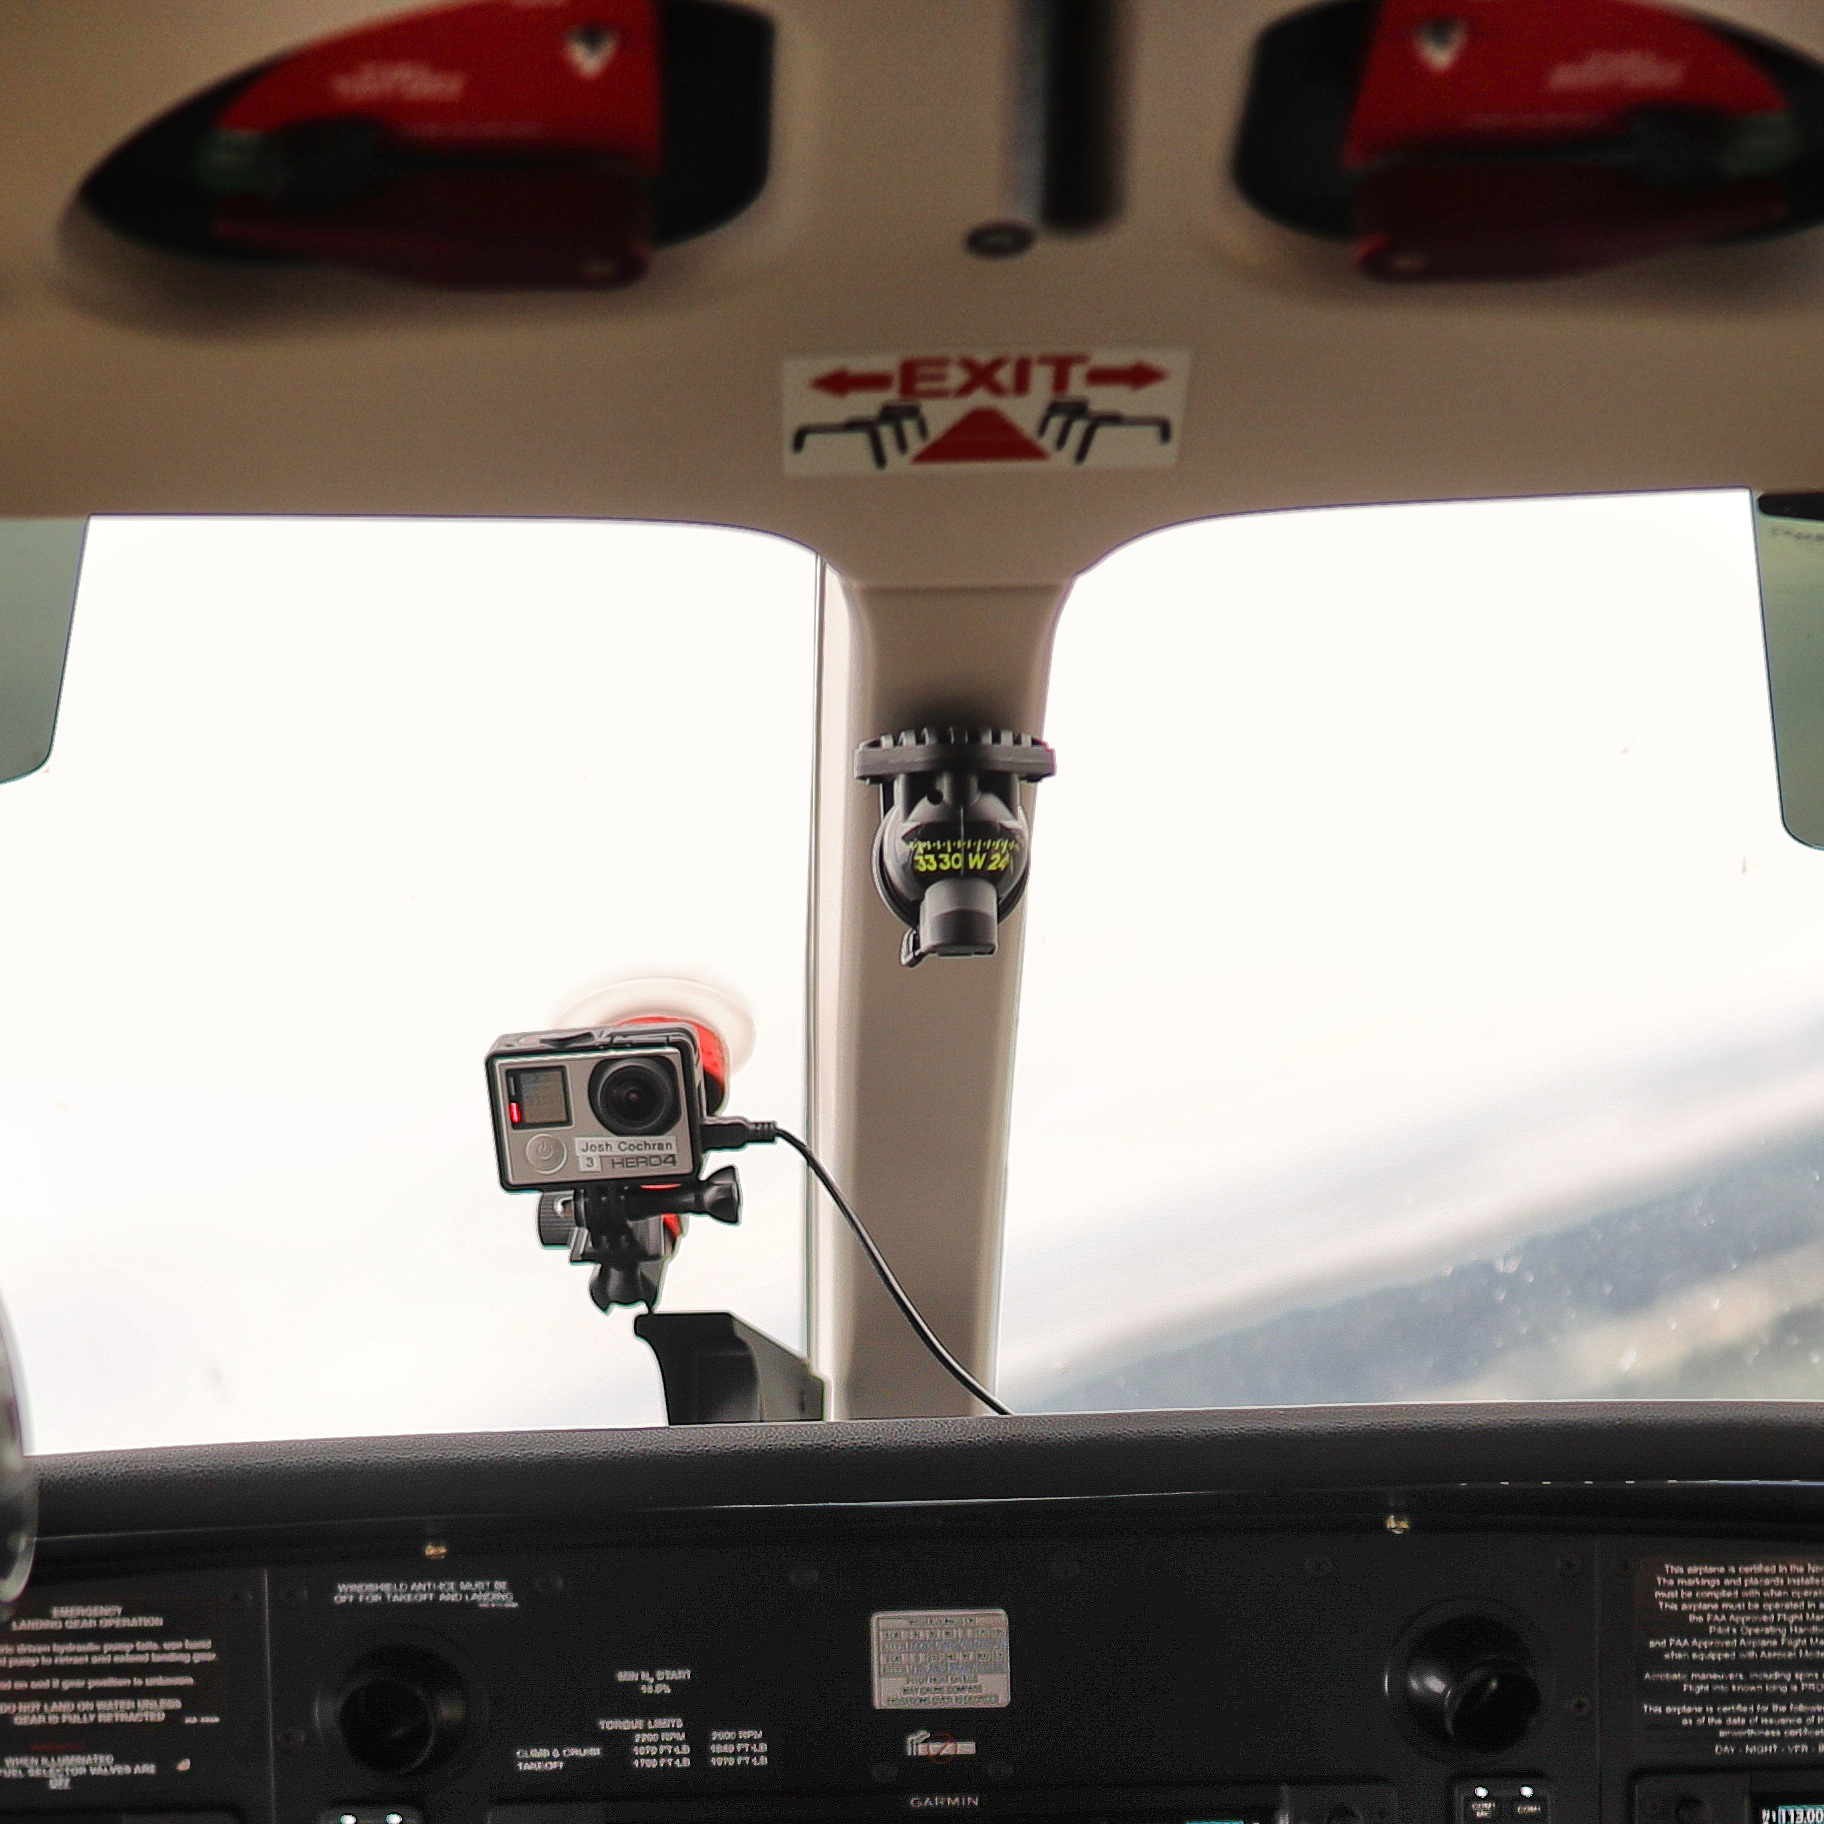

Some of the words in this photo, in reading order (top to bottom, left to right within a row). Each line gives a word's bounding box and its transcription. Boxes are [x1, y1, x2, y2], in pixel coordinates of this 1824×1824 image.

[898, 353, 1091, 399] EXIT
[580, 1142, 612, 1152] Josh
[618, 1141, 673, 1152] Cochran
[586, 1157, 594, 1168] 3
[612, 1155, 677, 1168] HERO4
[1665, 1564, 1684, 1575] This
[337, 1582, 407, 1592] WINDSHIELD
[494, 1581, 508, 1590] BE
[1656, 1576, 1674, 1587] The
[1724, 1576, 1741, 1587] and
[358, 1594, 382, 1603] FOR
[386, 1594, 434, 1602] TAKEOFF
[439, 1593, 462, 1602] AND
[465, 1592, 513, 1601] LANDING
[1659, 1601, 1678, 1611] This
[1748, 1601, 1760, 1611] be
[99, 1616, 163, 1628] OPERATION
[1707, 1613, 1726, 1623] FAA
[1715, 1744, 1735, 1755] DAY
[1745, 1744, 1778, 1755] NIGHT
[1788, 1744, 1808, 1755] VFR
[910, 1796, 979, 1808] GARMIN
[1781, 1808, 1824, 1824] 113.00
